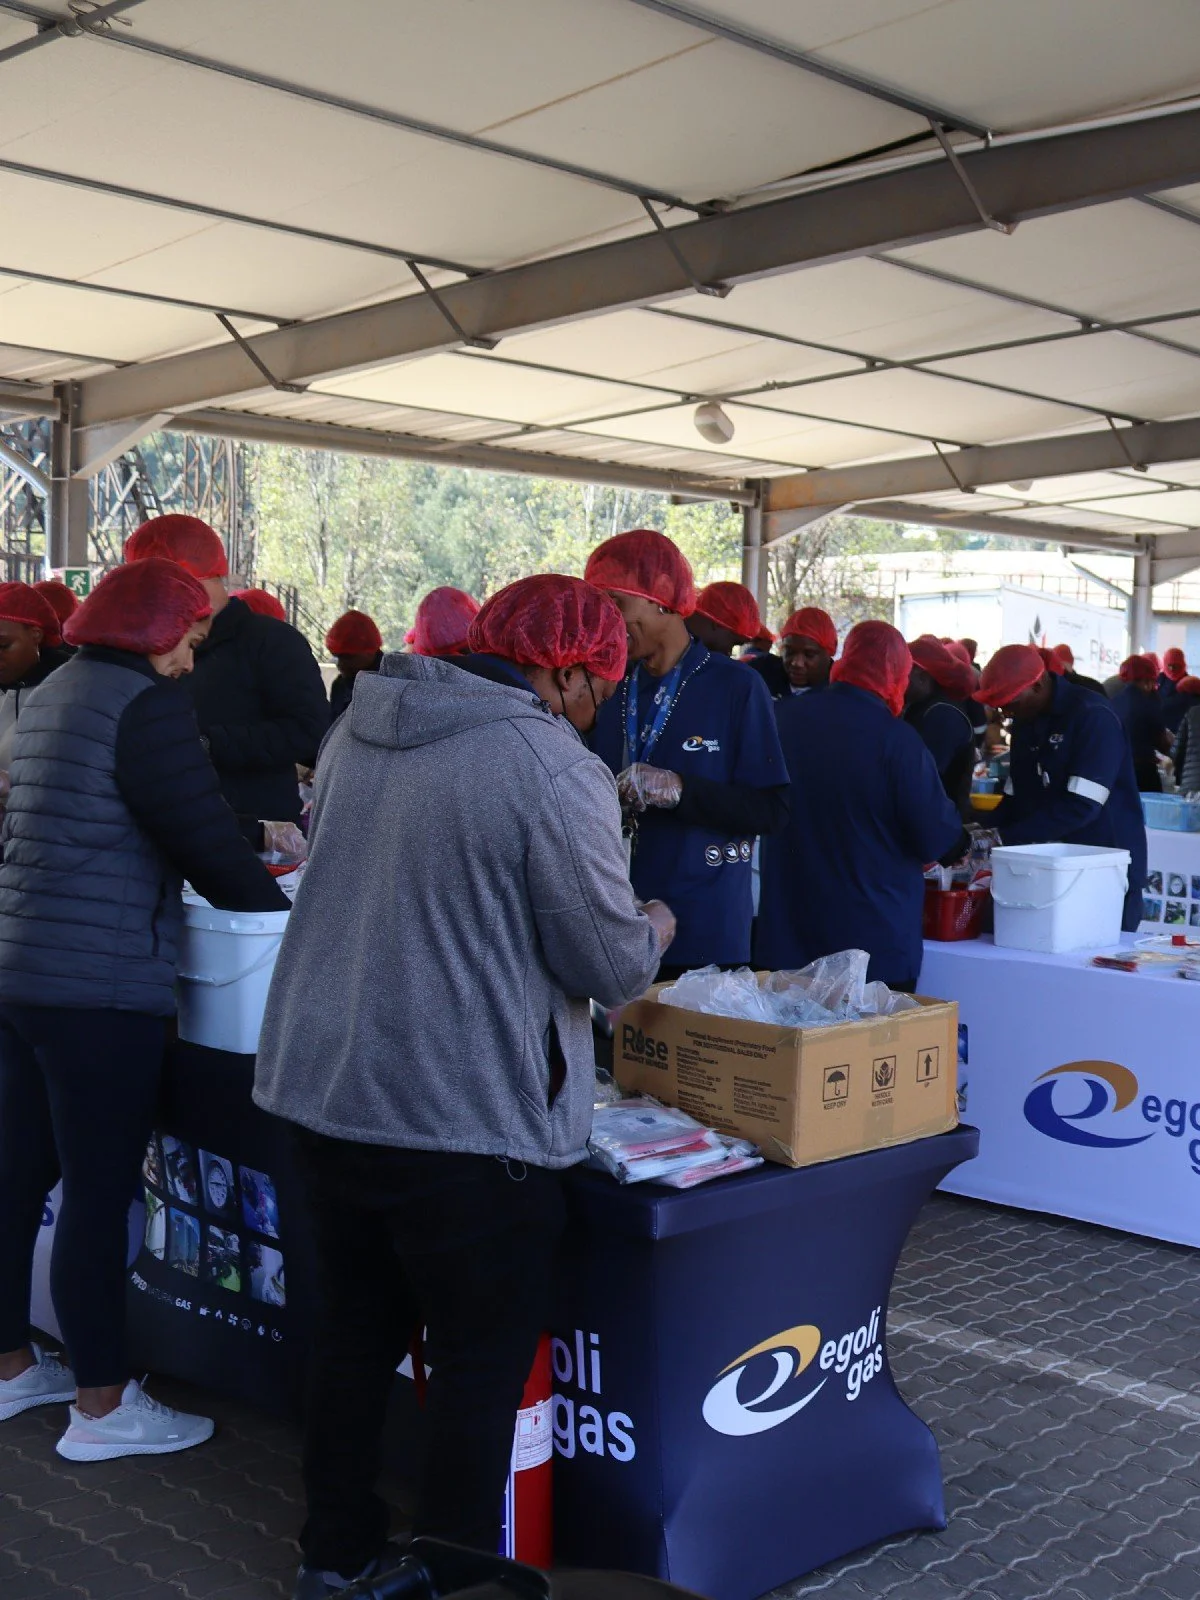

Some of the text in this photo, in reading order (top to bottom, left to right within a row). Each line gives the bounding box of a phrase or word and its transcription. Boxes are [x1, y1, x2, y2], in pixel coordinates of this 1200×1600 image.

[623, 1024, 669, 1061] Rise
[823, 1100, 847, 1110] KEEP DRY
[175, 1298, 192, 1312] GAS
[551, 1329, 602, 1395] oli
[820, 1306, 882, 1374] egoli
[846, 1343, 883, 1401] gas
[552, 1393, 636, 1462] gas
